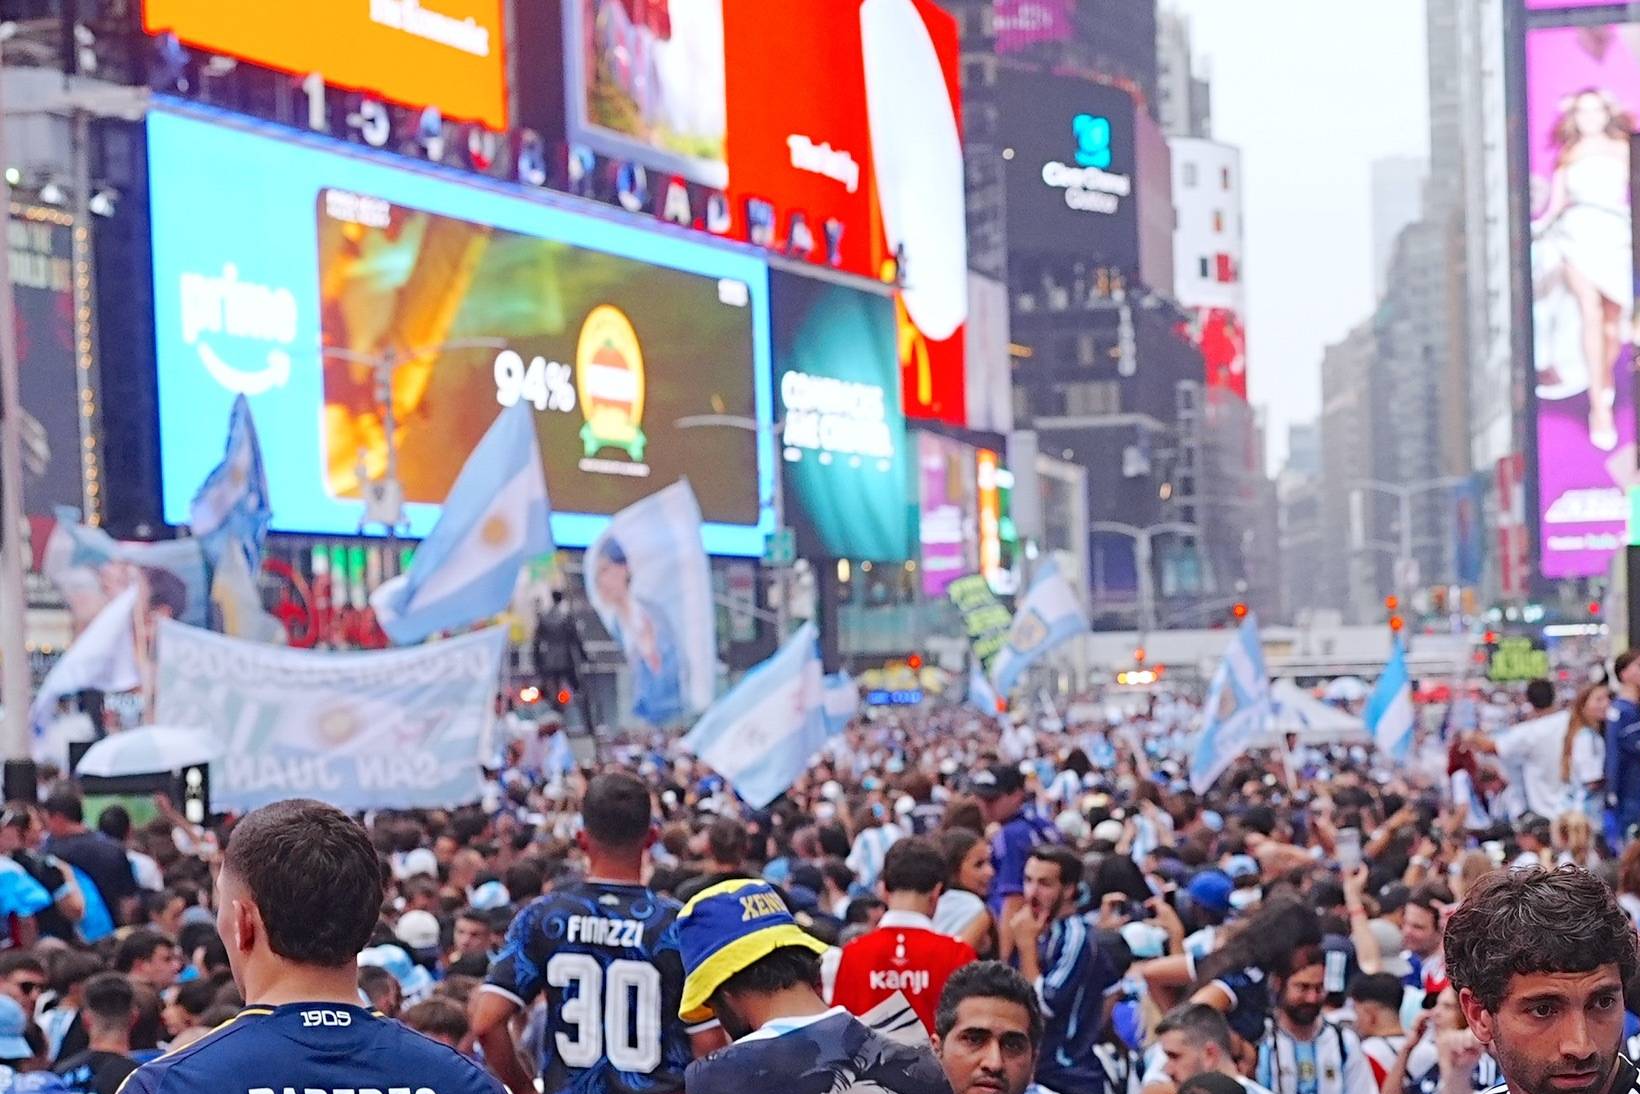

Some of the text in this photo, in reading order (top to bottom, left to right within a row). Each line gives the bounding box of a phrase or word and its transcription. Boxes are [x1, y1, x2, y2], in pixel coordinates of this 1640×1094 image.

[180, 261, 298, 345] prime
[494, 350, 576, 412] 94%
[301, 1009, 352, 1028] 1905
[547, 952, 662, 1074] 30
